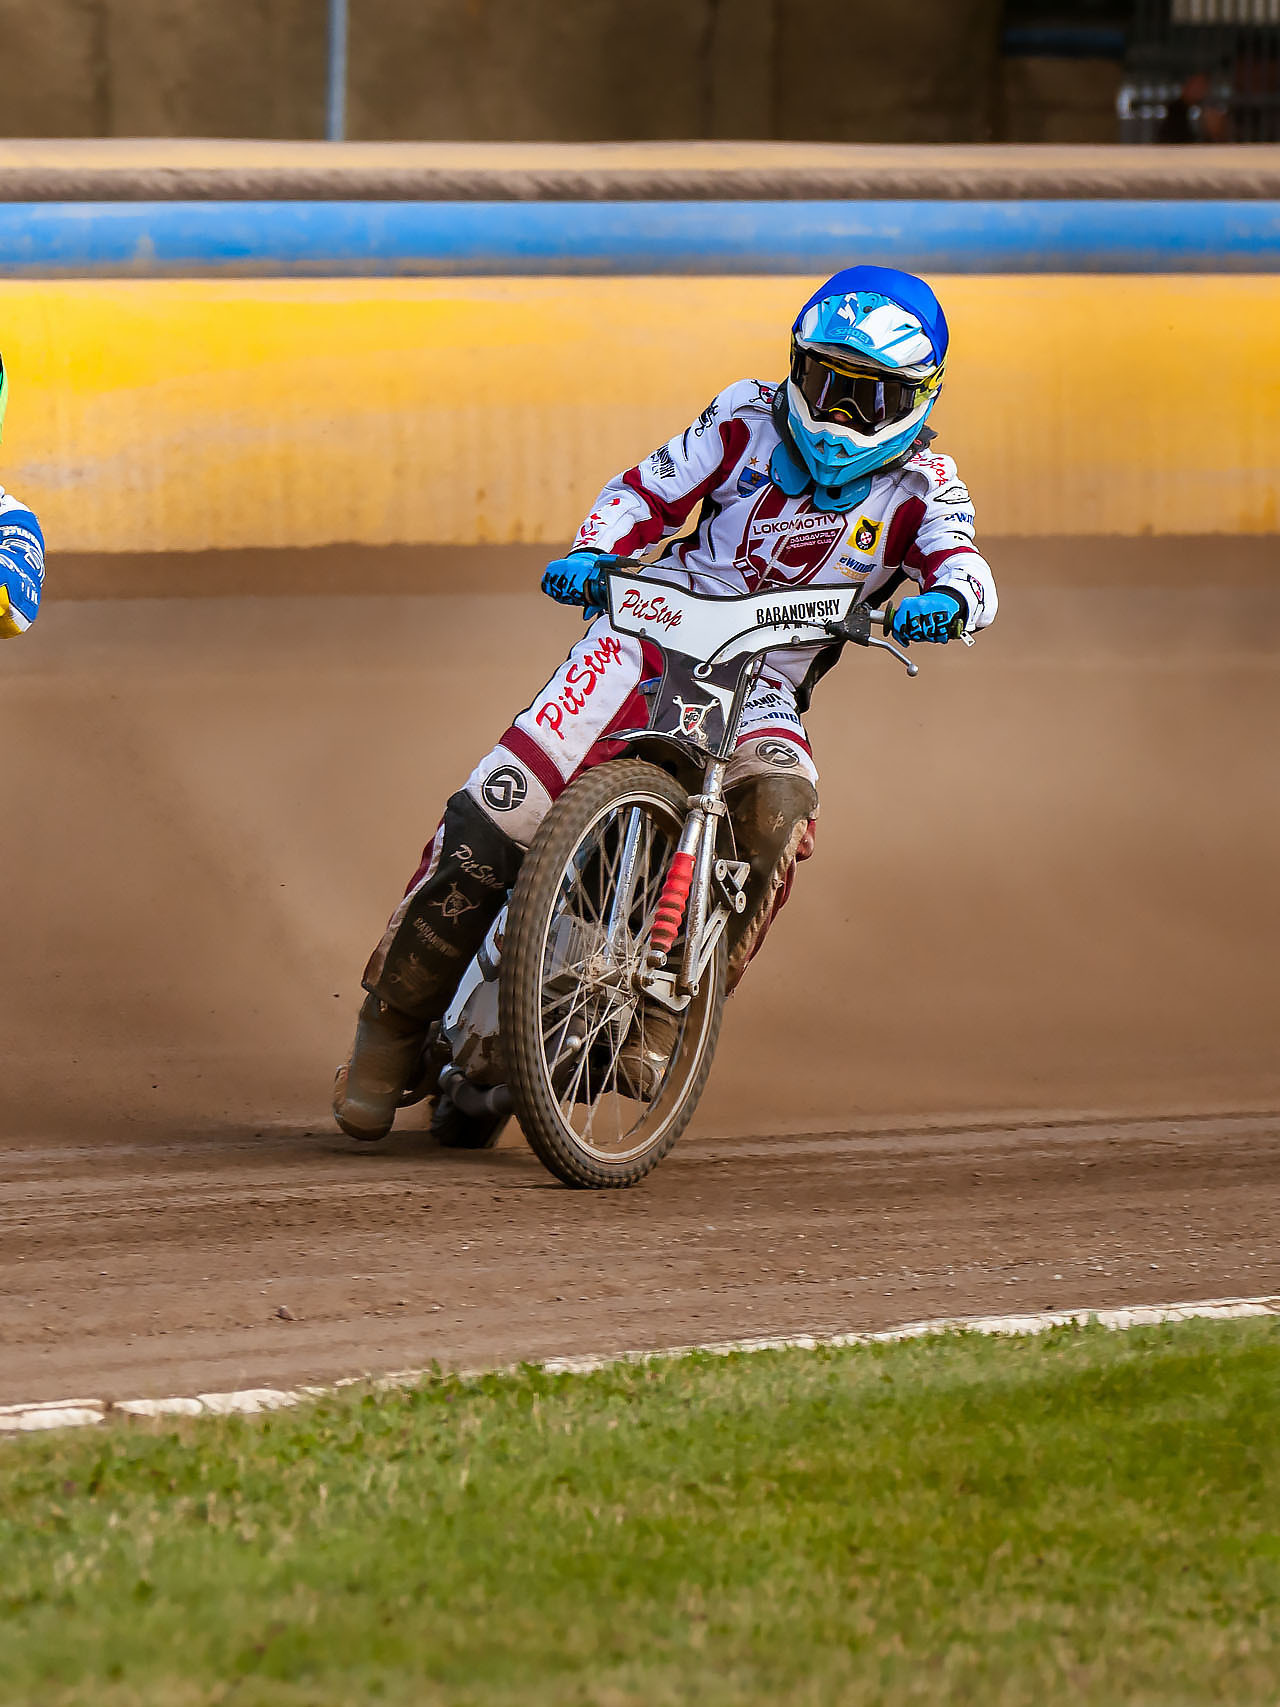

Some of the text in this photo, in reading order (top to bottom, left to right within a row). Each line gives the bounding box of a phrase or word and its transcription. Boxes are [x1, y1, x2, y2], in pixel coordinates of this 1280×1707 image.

[834, 327, 870, 345] SHOEI
[752, 513, 839, 536] LOKOMOTIV
[619, 589, 684, 632] PitStop
[756, 599, 840, 625] BARANOWSKY
[535, 636, 623, 741] PitStop
